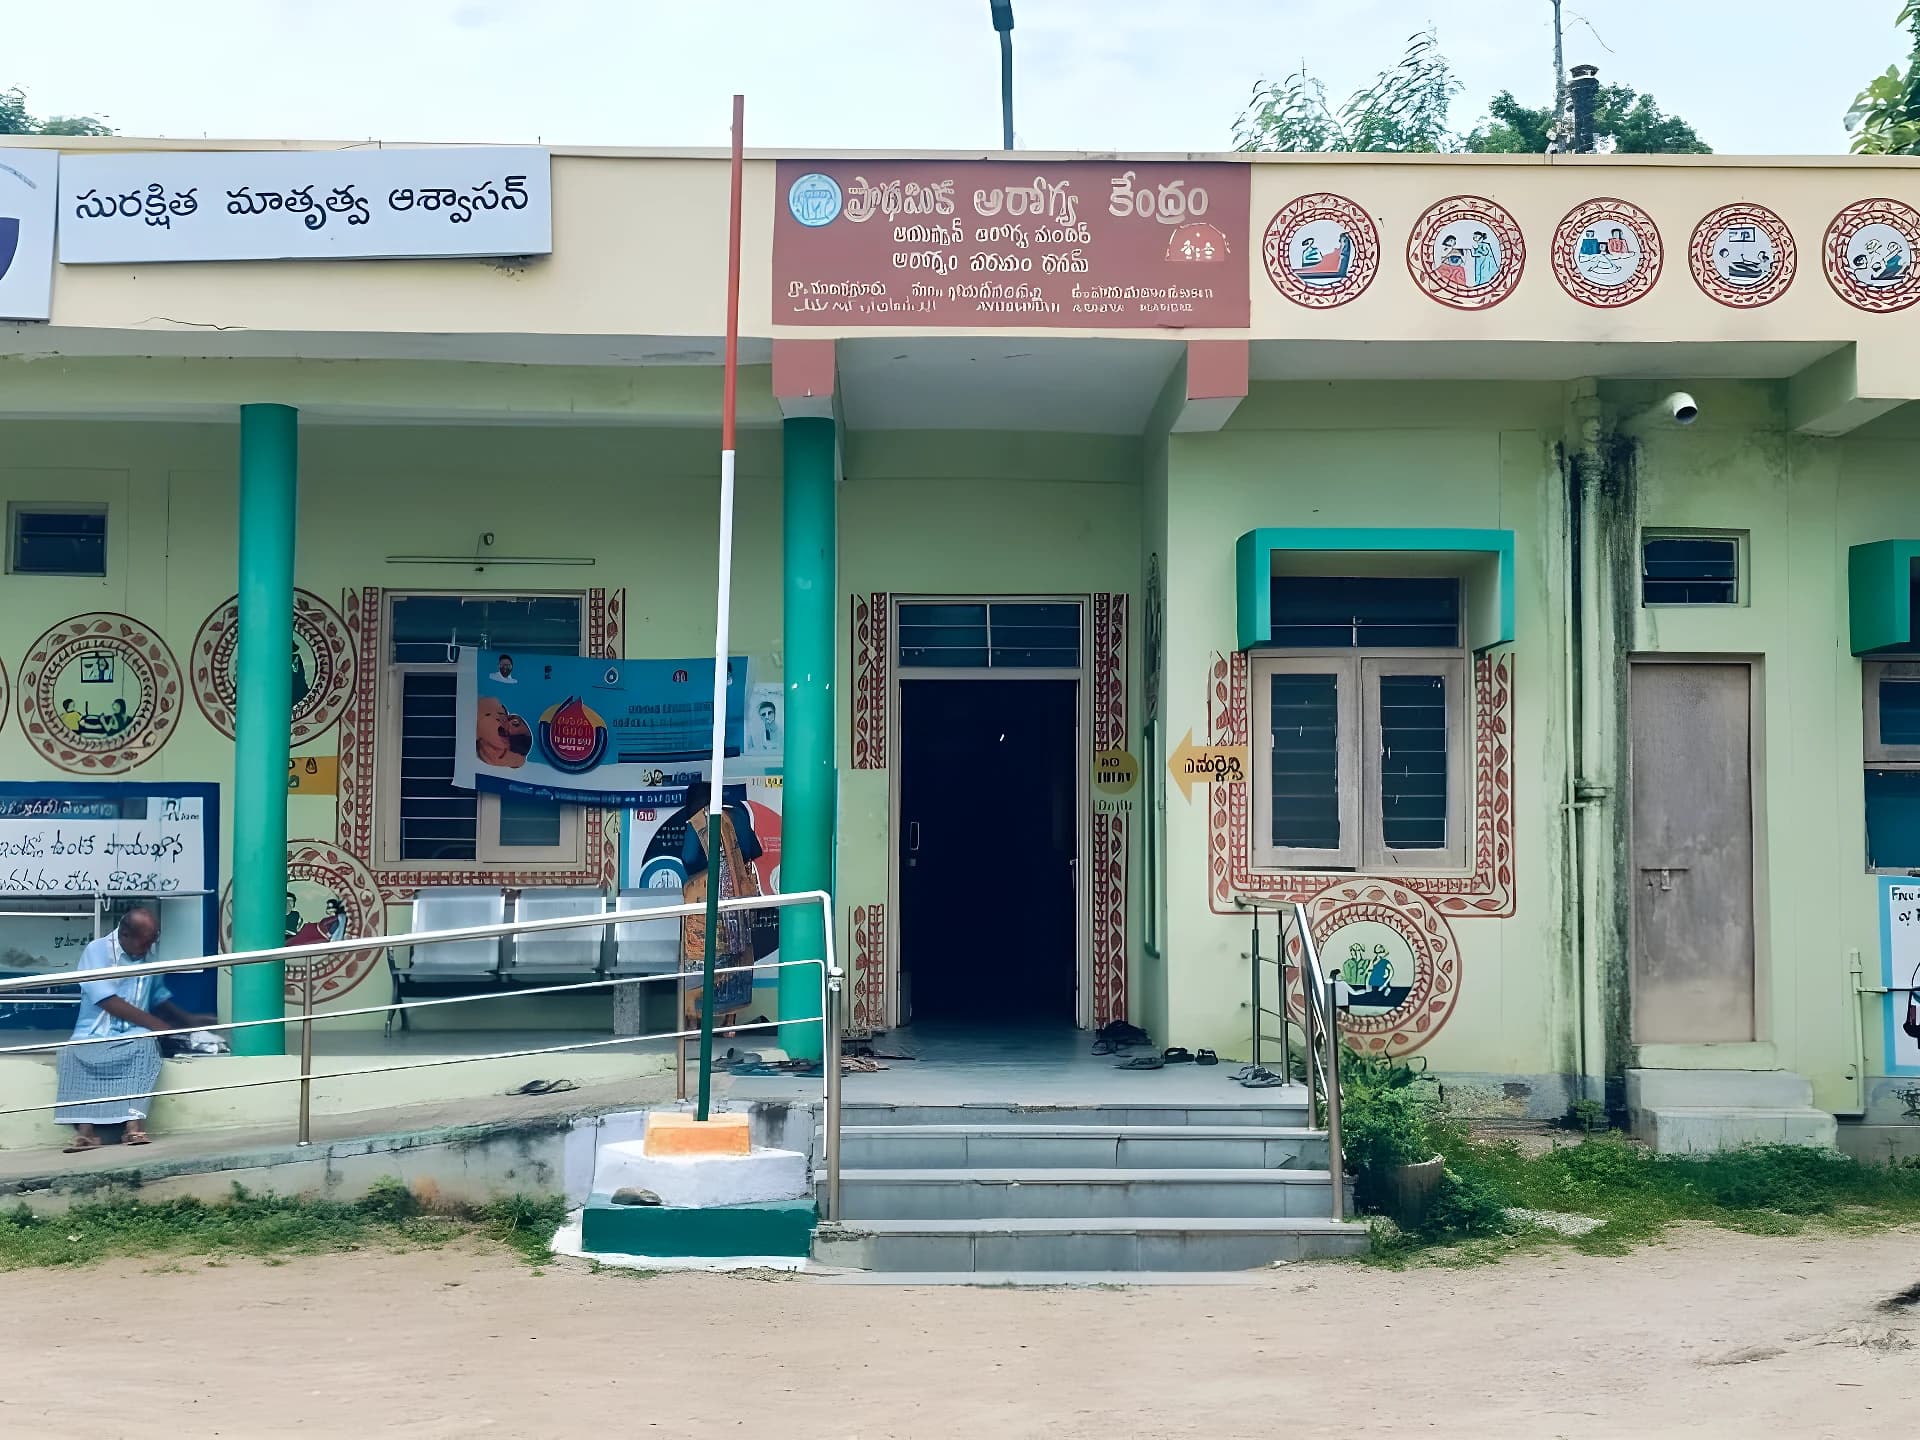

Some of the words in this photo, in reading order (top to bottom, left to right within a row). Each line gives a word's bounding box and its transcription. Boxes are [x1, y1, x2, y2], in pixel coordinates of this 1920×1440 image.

[76, 183, 198, 229] సురక్షిత
[226, 185, 370, 230] మాతృత్వ
[388, 175, 529, 224] ఆశ్వాసన్
[973, 176, 1079, 226] ఆరోగ్య
[1108, 170, 1209, 224] కేంద్రం
